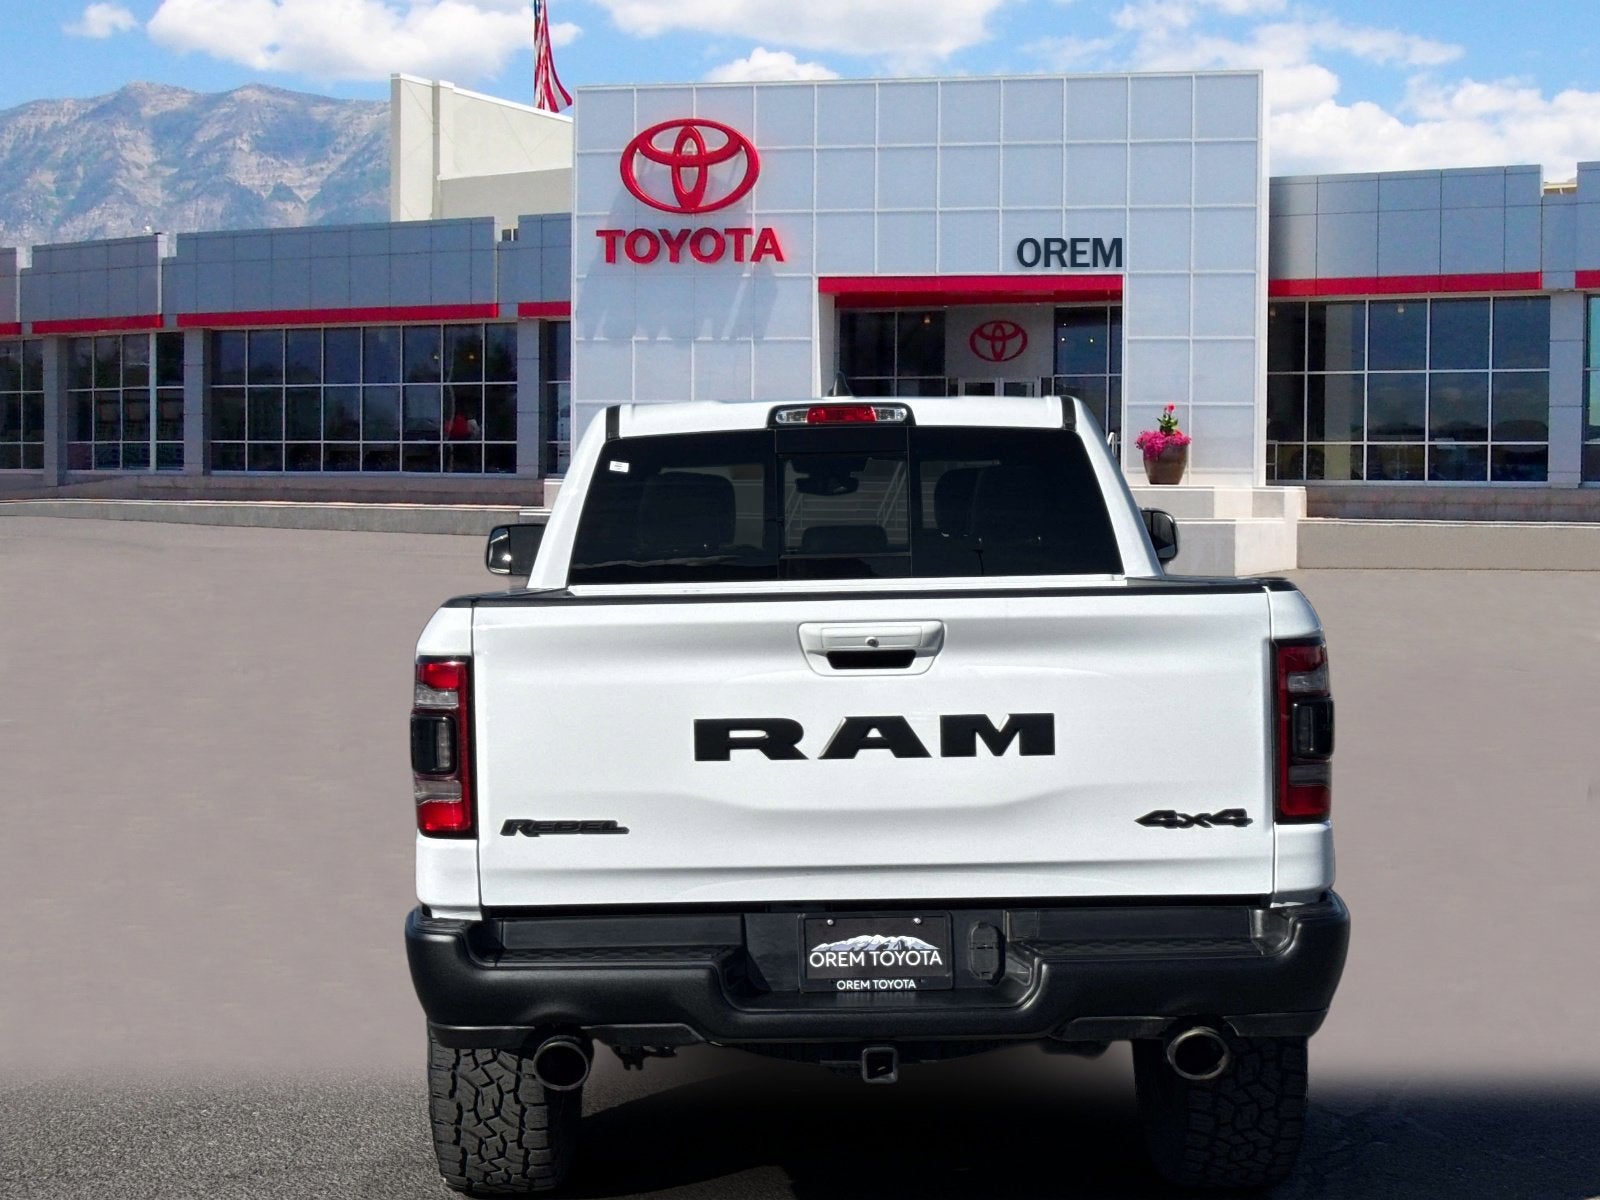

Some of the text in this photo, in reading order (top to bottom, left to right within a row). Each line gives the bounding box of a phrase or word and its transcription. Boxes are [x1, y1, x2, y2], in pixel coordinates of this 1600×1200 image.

[596, 228, 785, 264] TOYOTA
[1016, 237, 1123, 268] OREM
[693, 712, 1056, 762] RAM
[809, 949, 943, 968] OREM TOYOTA
[836, 979, 917, 991] OREM TOYOTA
